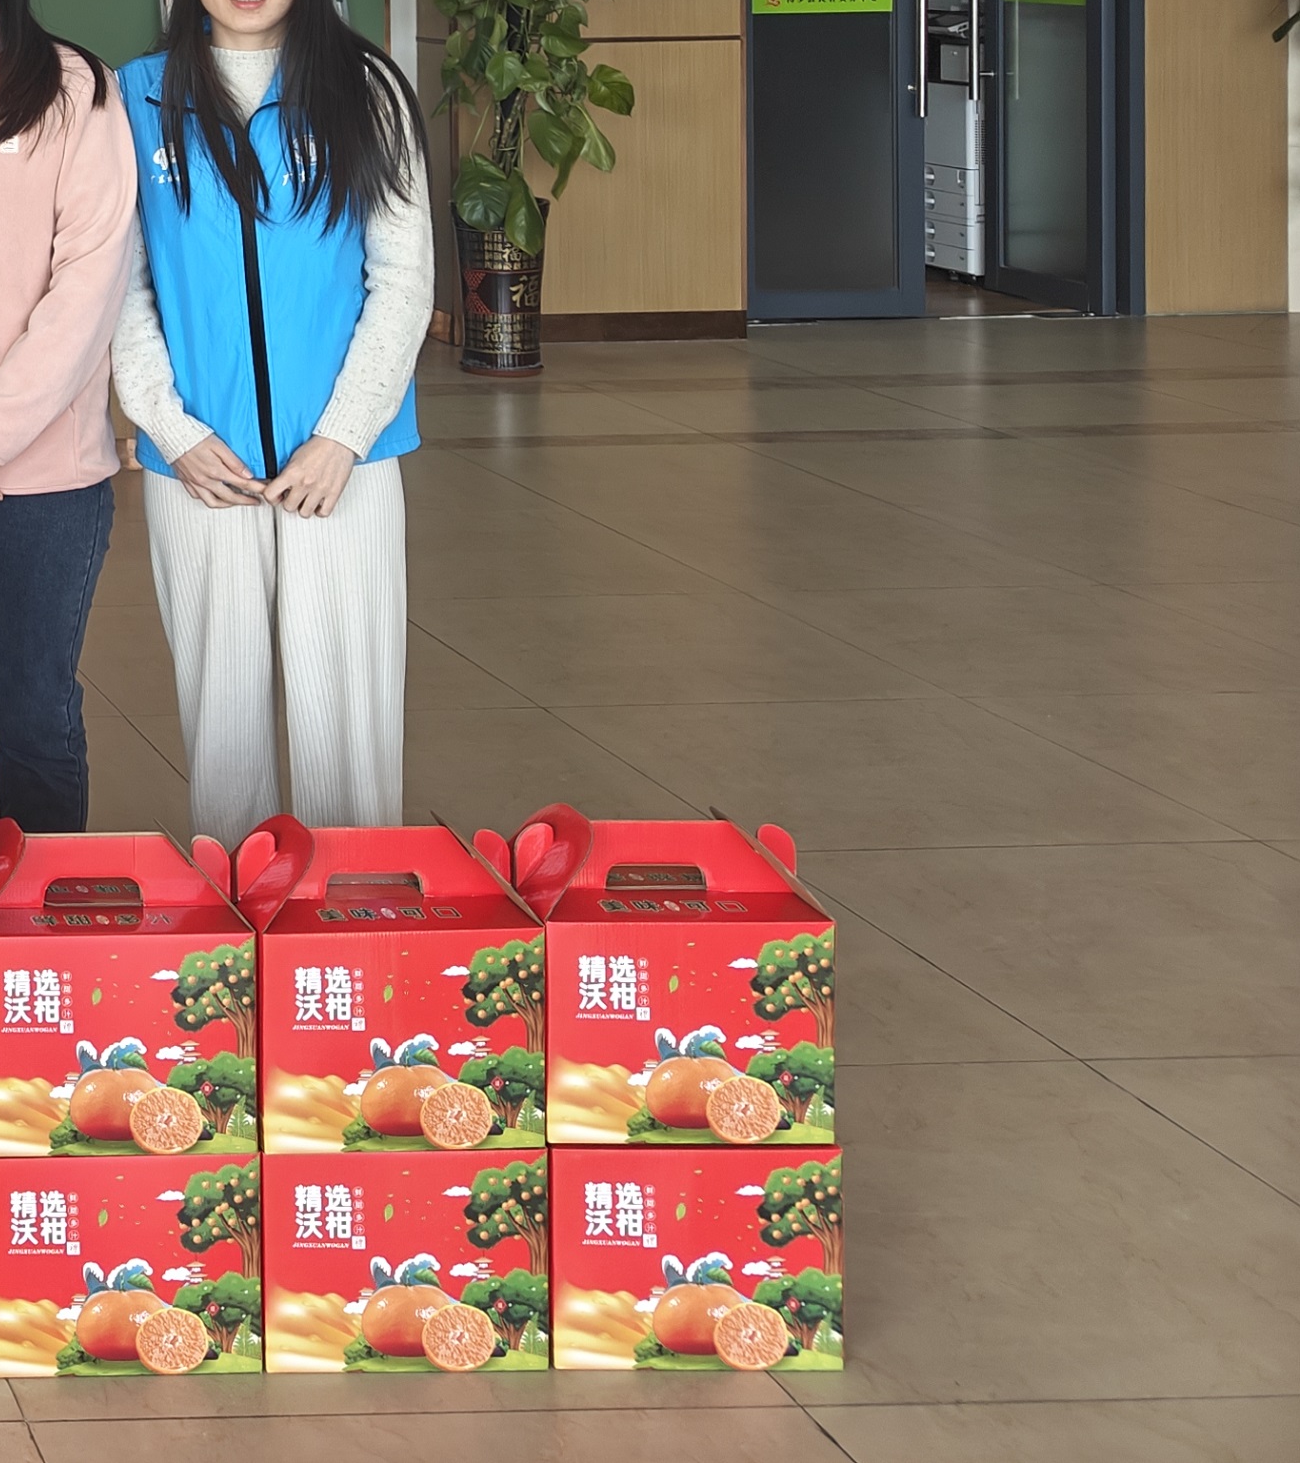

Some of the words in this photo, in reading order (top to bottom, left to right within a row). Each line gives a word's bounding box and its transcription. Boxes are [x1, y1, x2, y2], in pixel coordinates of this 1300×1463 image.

[316, 908, 381, 922] 美味
[396, 907, 463, 921] 可口
[598, 899, 666, 913] 美味
[679, 899, 748, 913] 可口
[294, 966, 352, 994] 精选
[578, 954, 637, 983] 精选
[2, 969, 60, 996] 精选
[3, 997, 60, 1024] 沃柑
[295, 995, 352, 1021] 沃柑
[578, 983, 637, 1011] 沃柑
[10, 1190, 67, 1218] 精选
[294, 1184, 352, 1212] 精选
[584, 1181, 643, 1210] 精选
[10, 1218, 67, 1245] 沃柑
[294, 1212, 352, 1239] 沃柑
[584, 1209, 643, 1237] 沃柑
